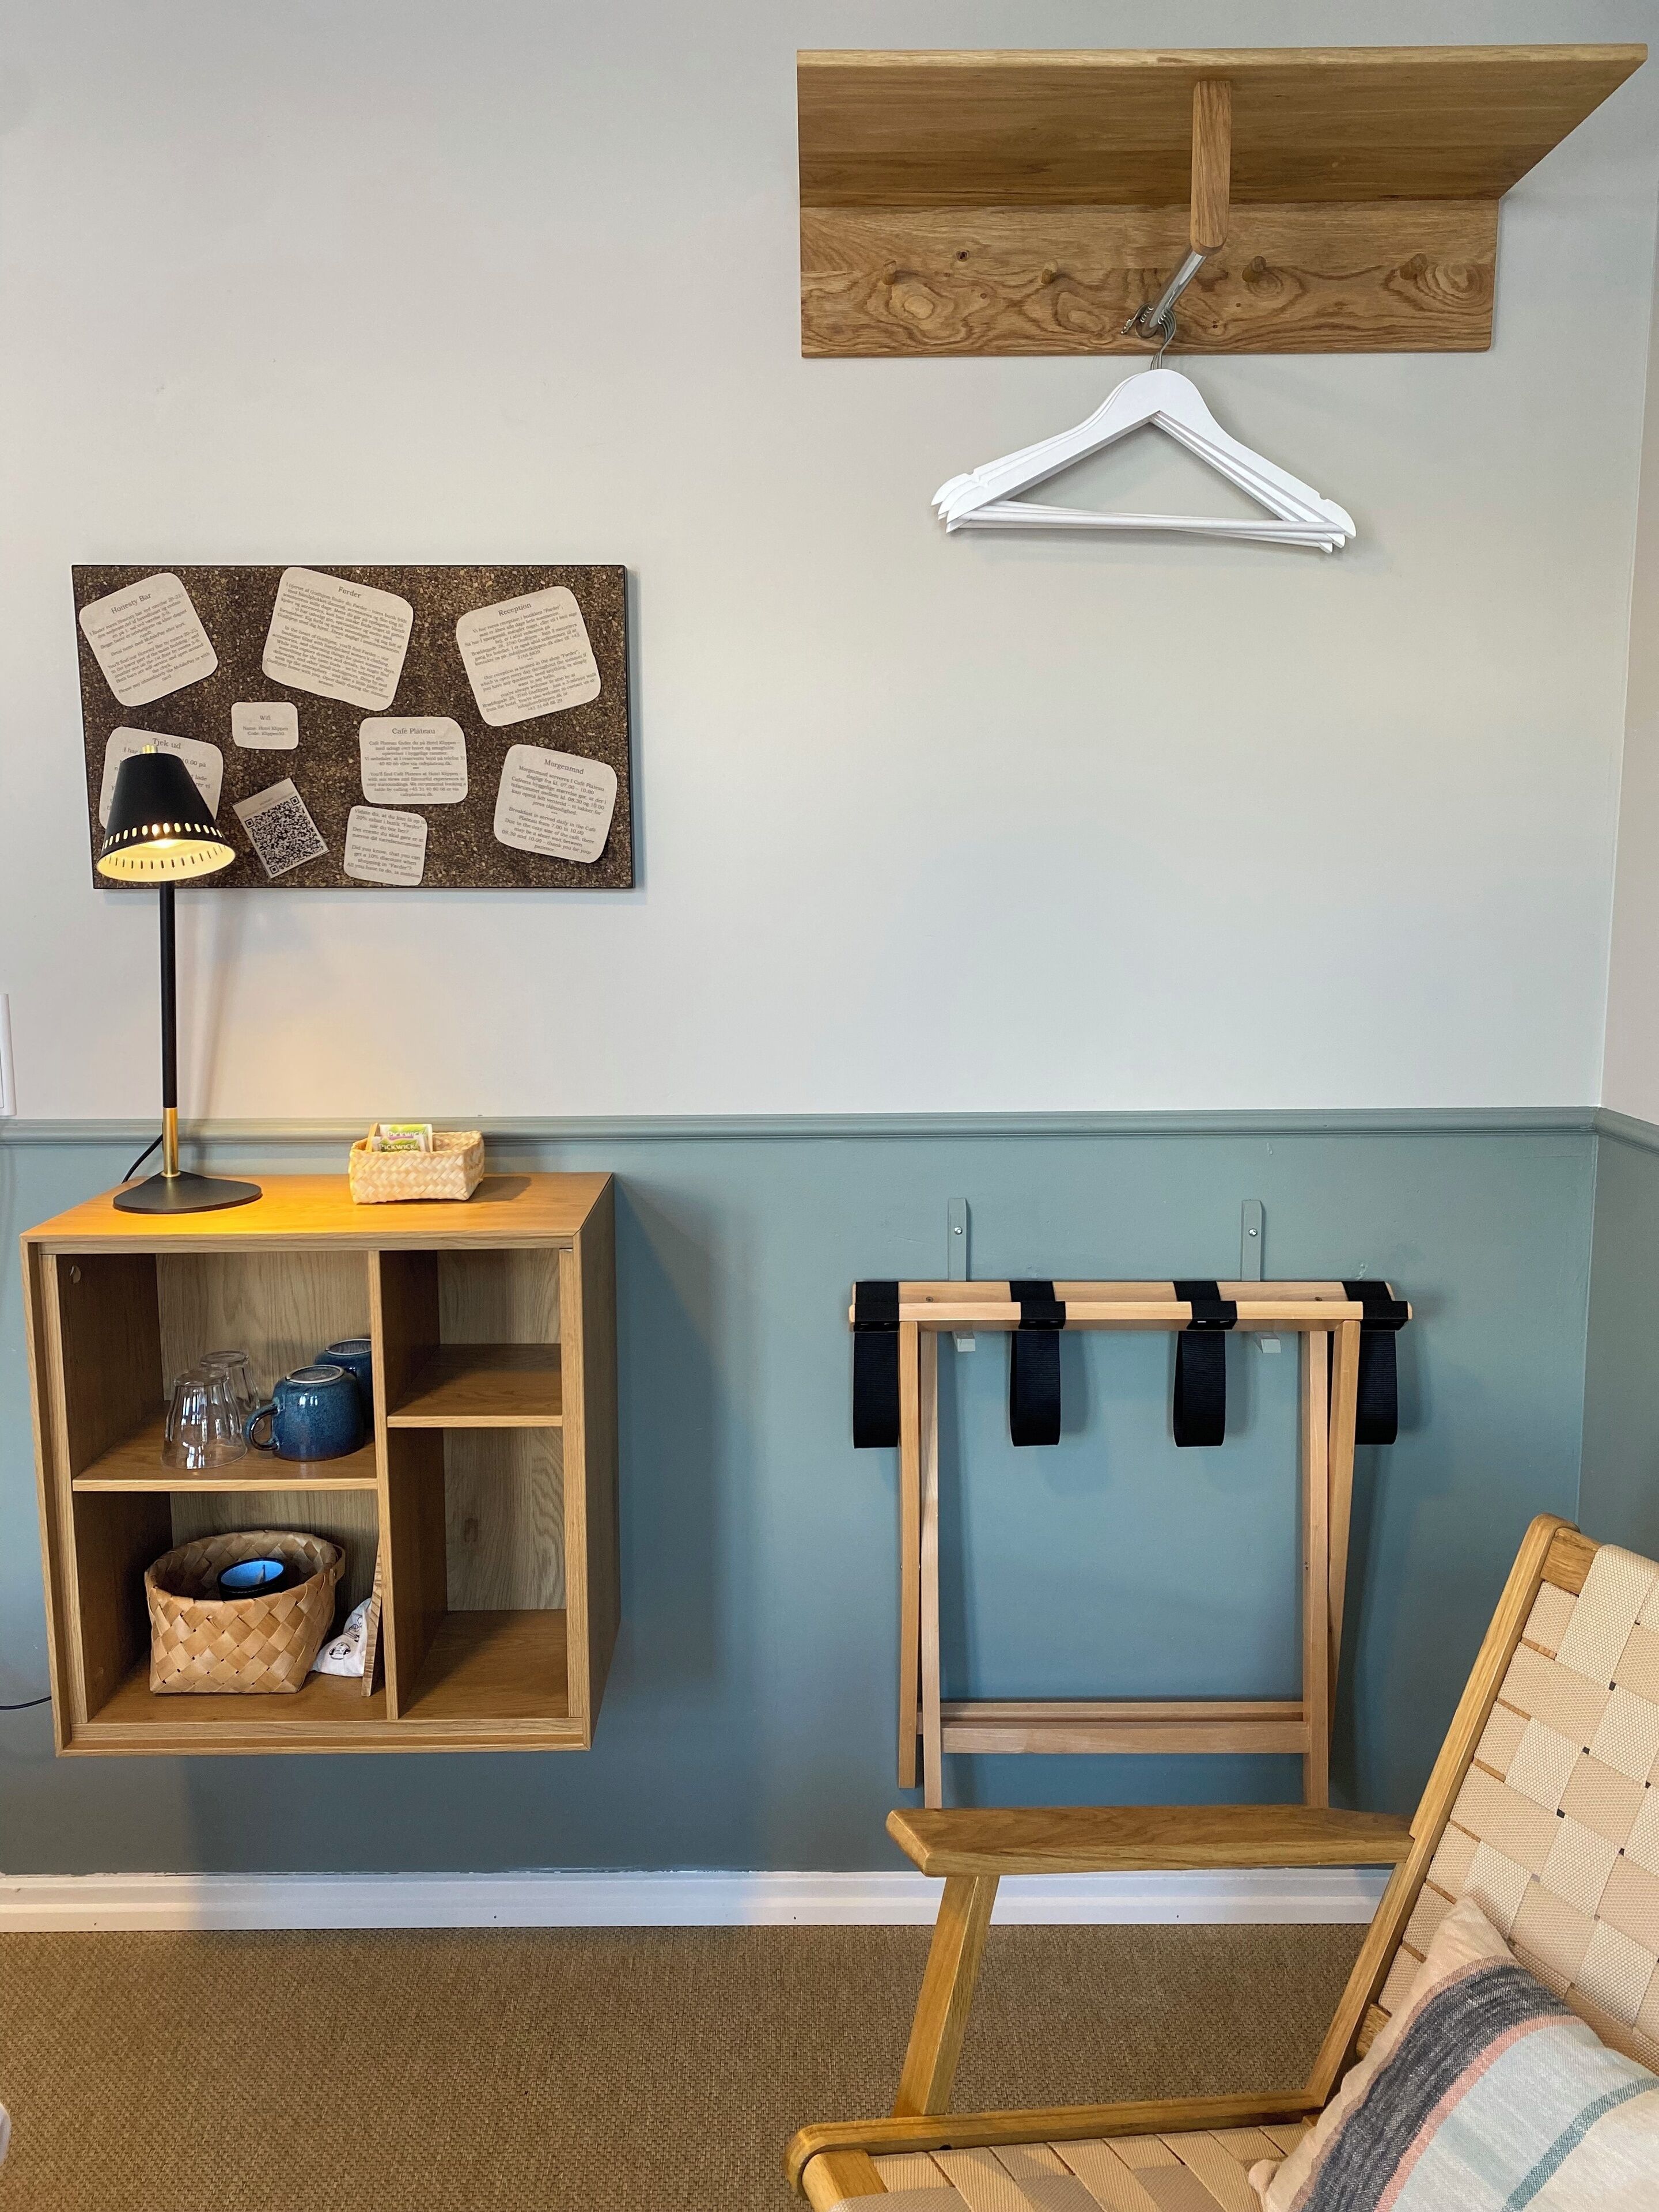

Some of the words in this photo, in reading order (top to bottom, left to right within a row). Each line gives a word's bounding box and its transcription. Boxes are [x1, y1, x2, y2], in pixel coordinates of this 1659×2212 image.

[338, 586, 361, 598] Førder
[111, 598, 139, 615] Honesty
[138, 593, 151, 601] Bar
[498, 601, 532, 617] Reception
[152, 738, 169, 747] Tjek
[543, 759, 584, 775] Morgenmad
